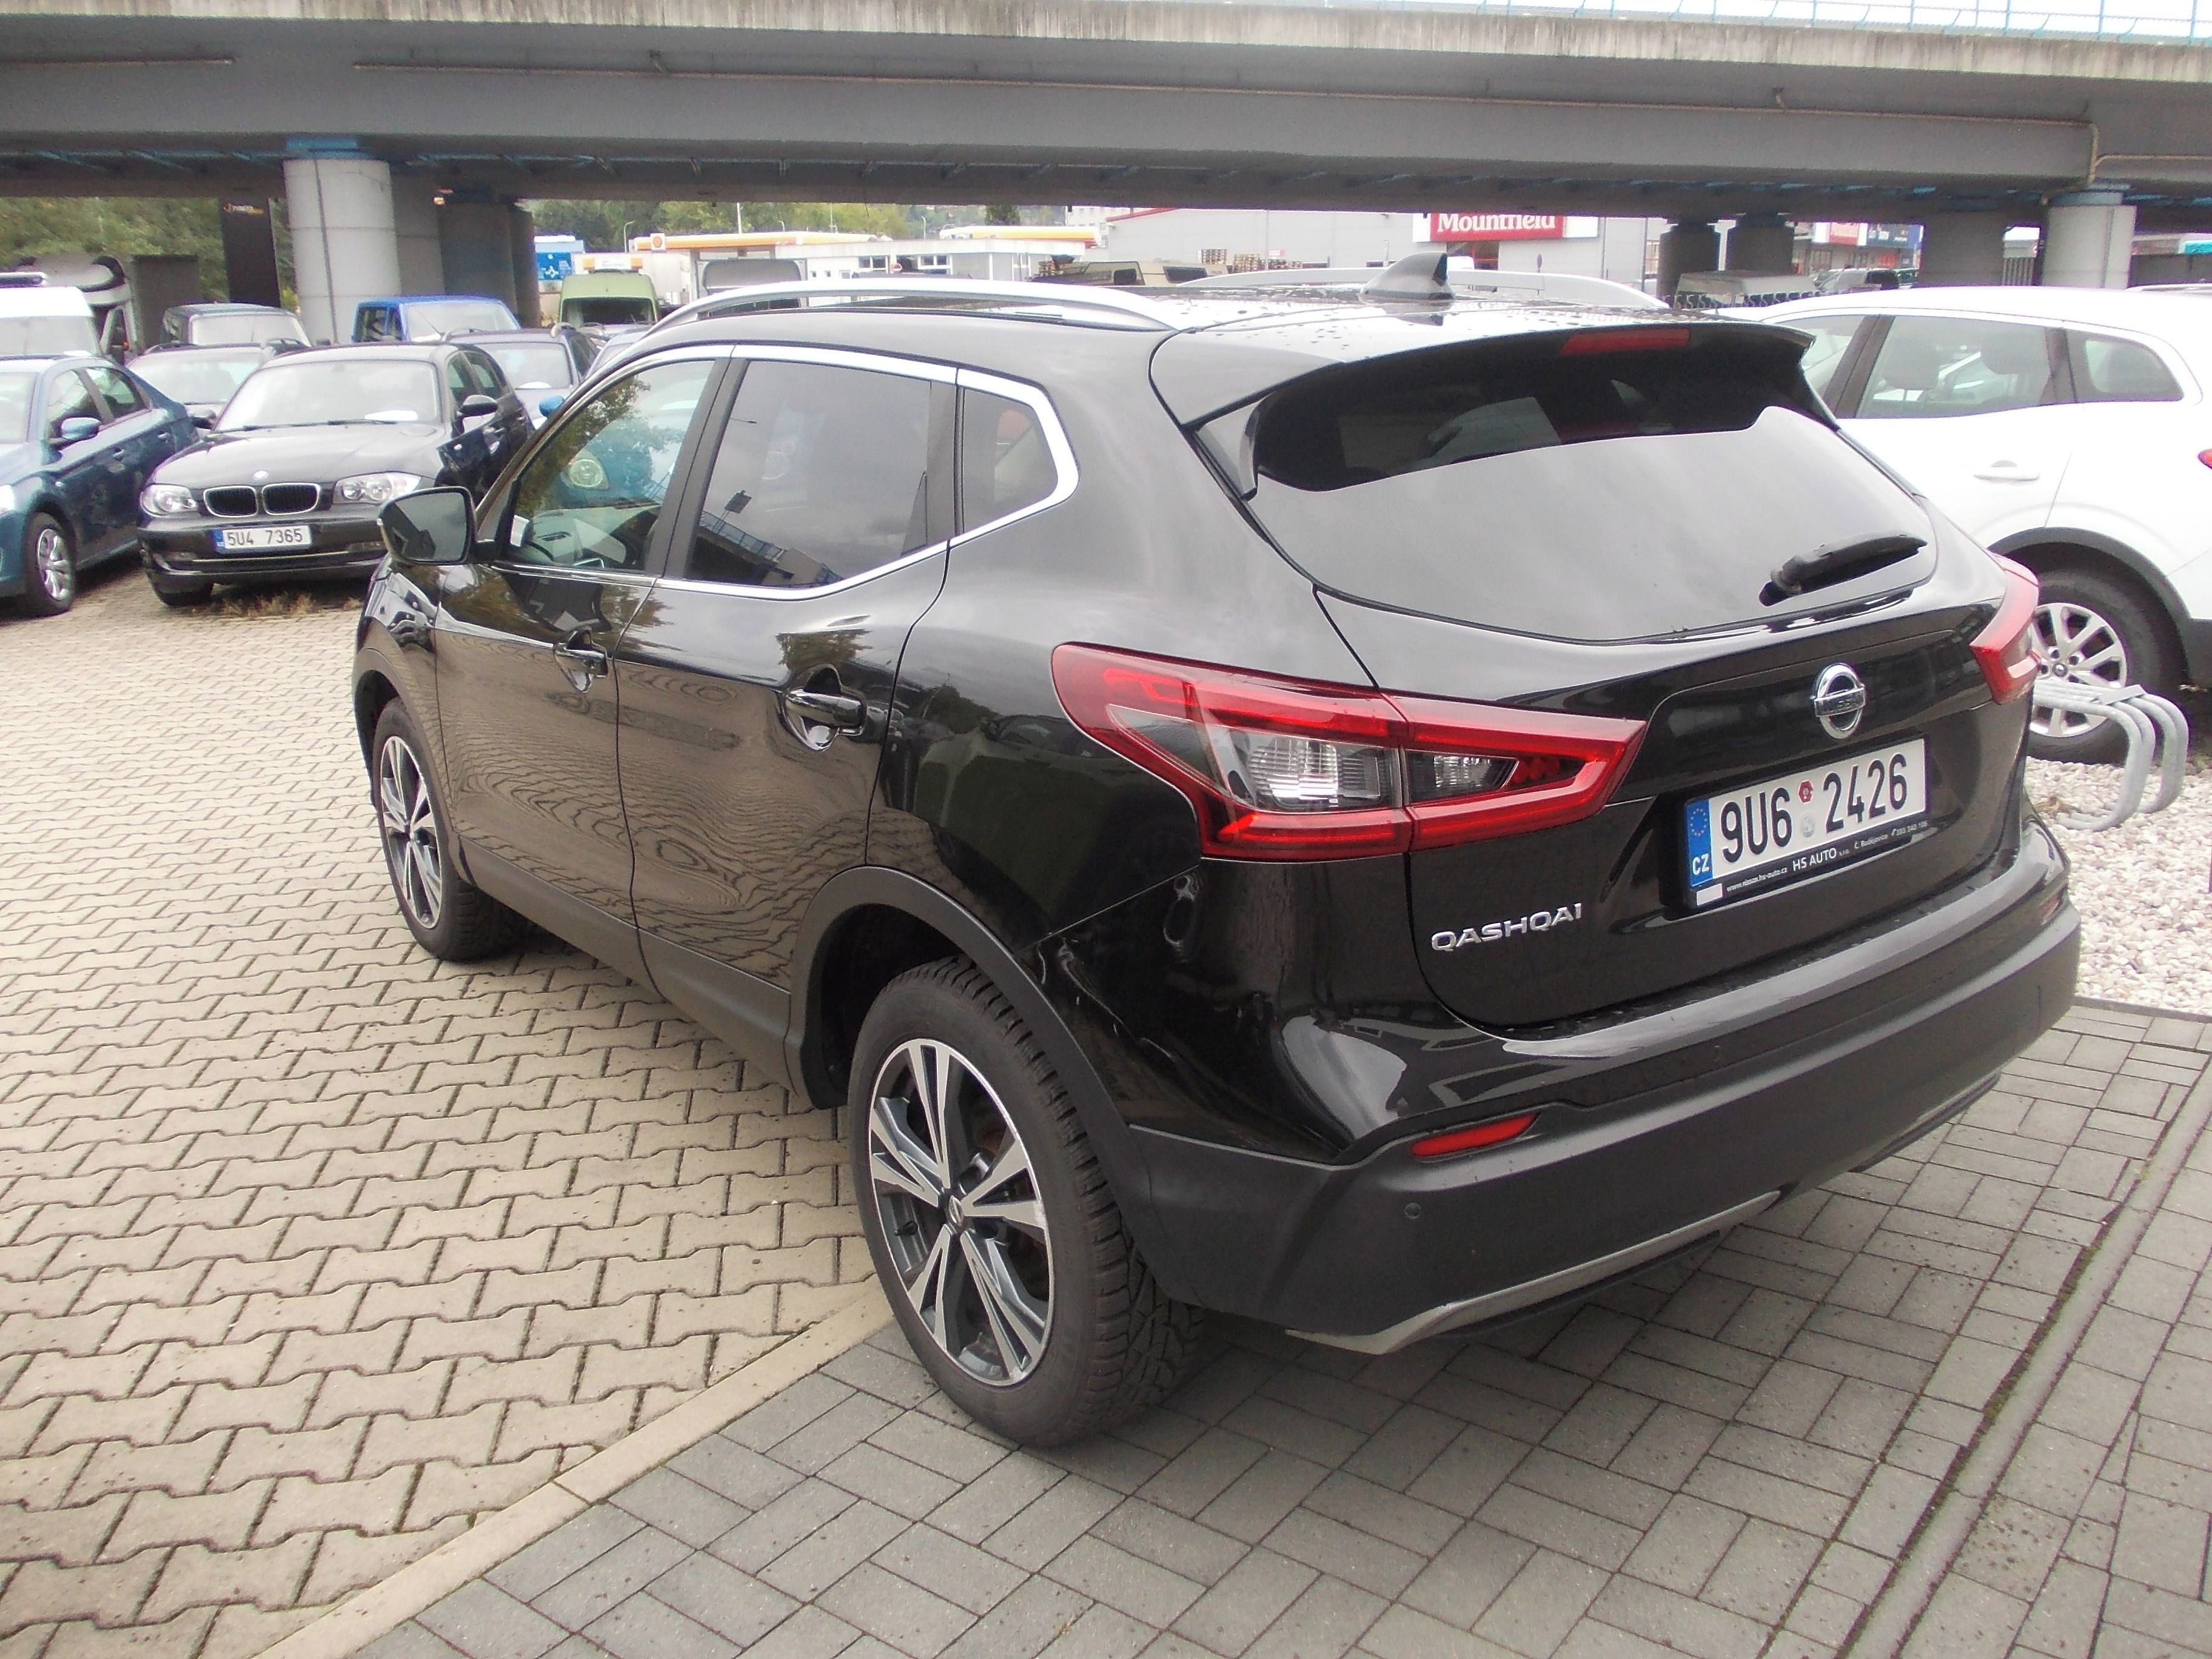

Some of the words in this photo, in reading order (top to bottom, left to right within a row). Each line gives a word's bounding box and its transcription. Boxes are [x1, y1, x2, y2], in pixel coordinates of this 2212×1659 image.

[227, 532, 254, 546] 5U4
[266, 528, 303, 544] 7365
[1720, 787, 1792, 863] 9U6
[1823, 752, 1908, 833] 2426
[1692, 854, 1710, 876] CZ
[1792, 857, 1808, 872] HS
[1809, 847, 1837, 866] AUTO
[1431, 902, 1582, 951] QASHQAI
